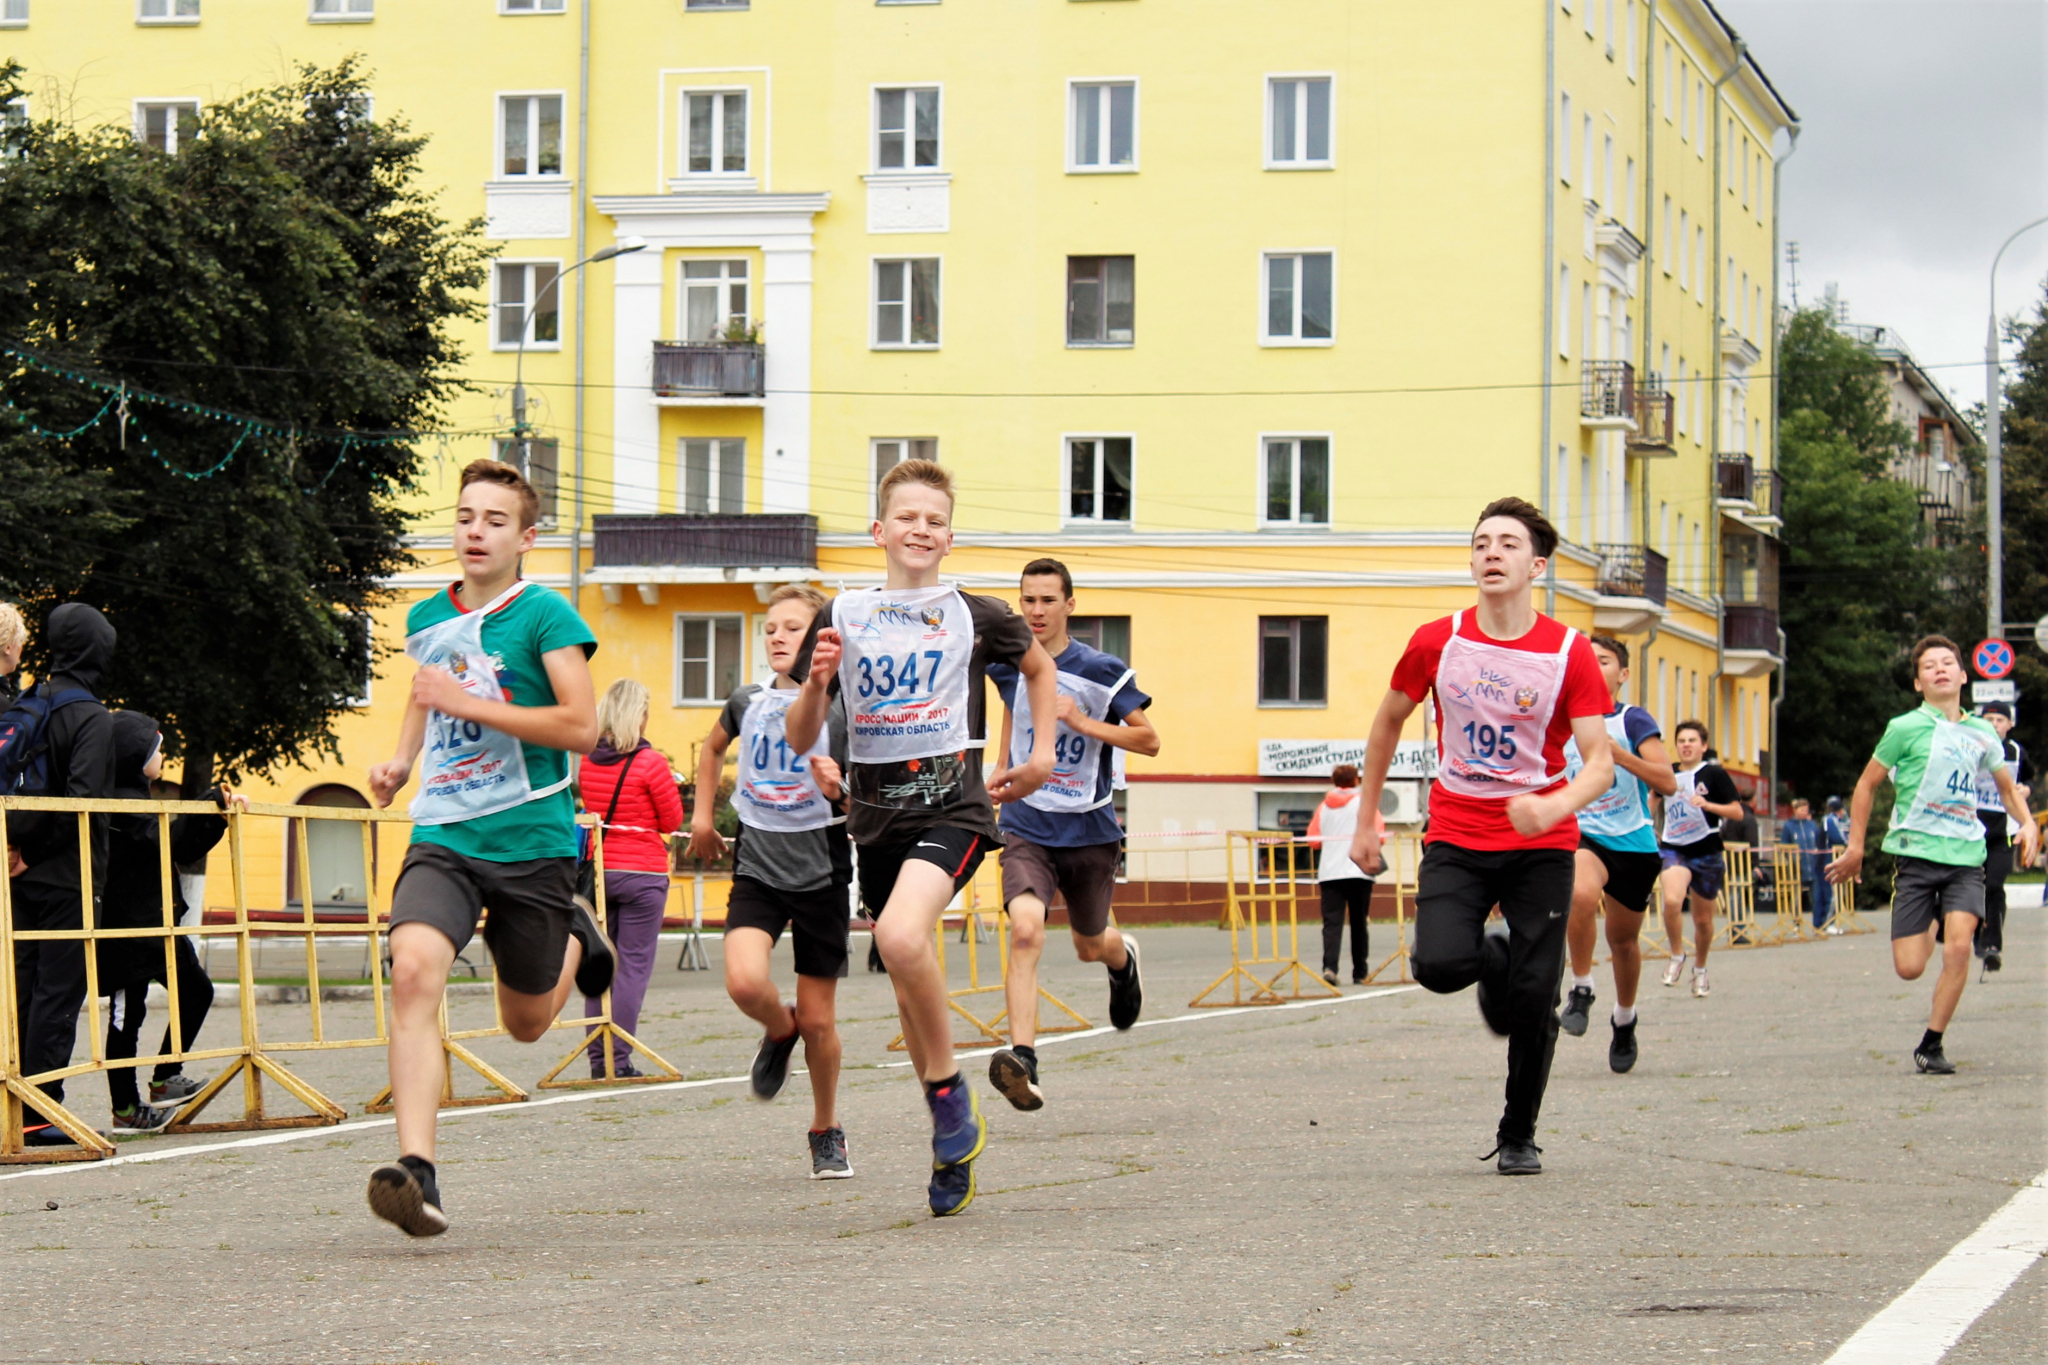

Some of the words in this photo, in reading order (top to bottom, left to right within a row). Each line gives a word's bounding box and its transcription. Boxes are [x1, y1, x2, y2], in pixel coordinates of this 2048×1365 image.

[857, 651, 943, 698] 3347
[855, 714, 880, 724] КРОСС
[884, 712, 919, 724] НАЦИИ
[927, 708, 949, 719] 2017
[855, 726, 904, 736] КИРОВСКАЯ
[906, 721, 951, 734] ОБЛАСТЬ
[1463, 721, 1517, 760] 195
[1268, 745, 1329, 760] МОРОЖЕНОЕ
[1276, 755, 1323, 771] СКИДКИ
[1050, 786, 1083, 798] ОБЛАСТЬ
